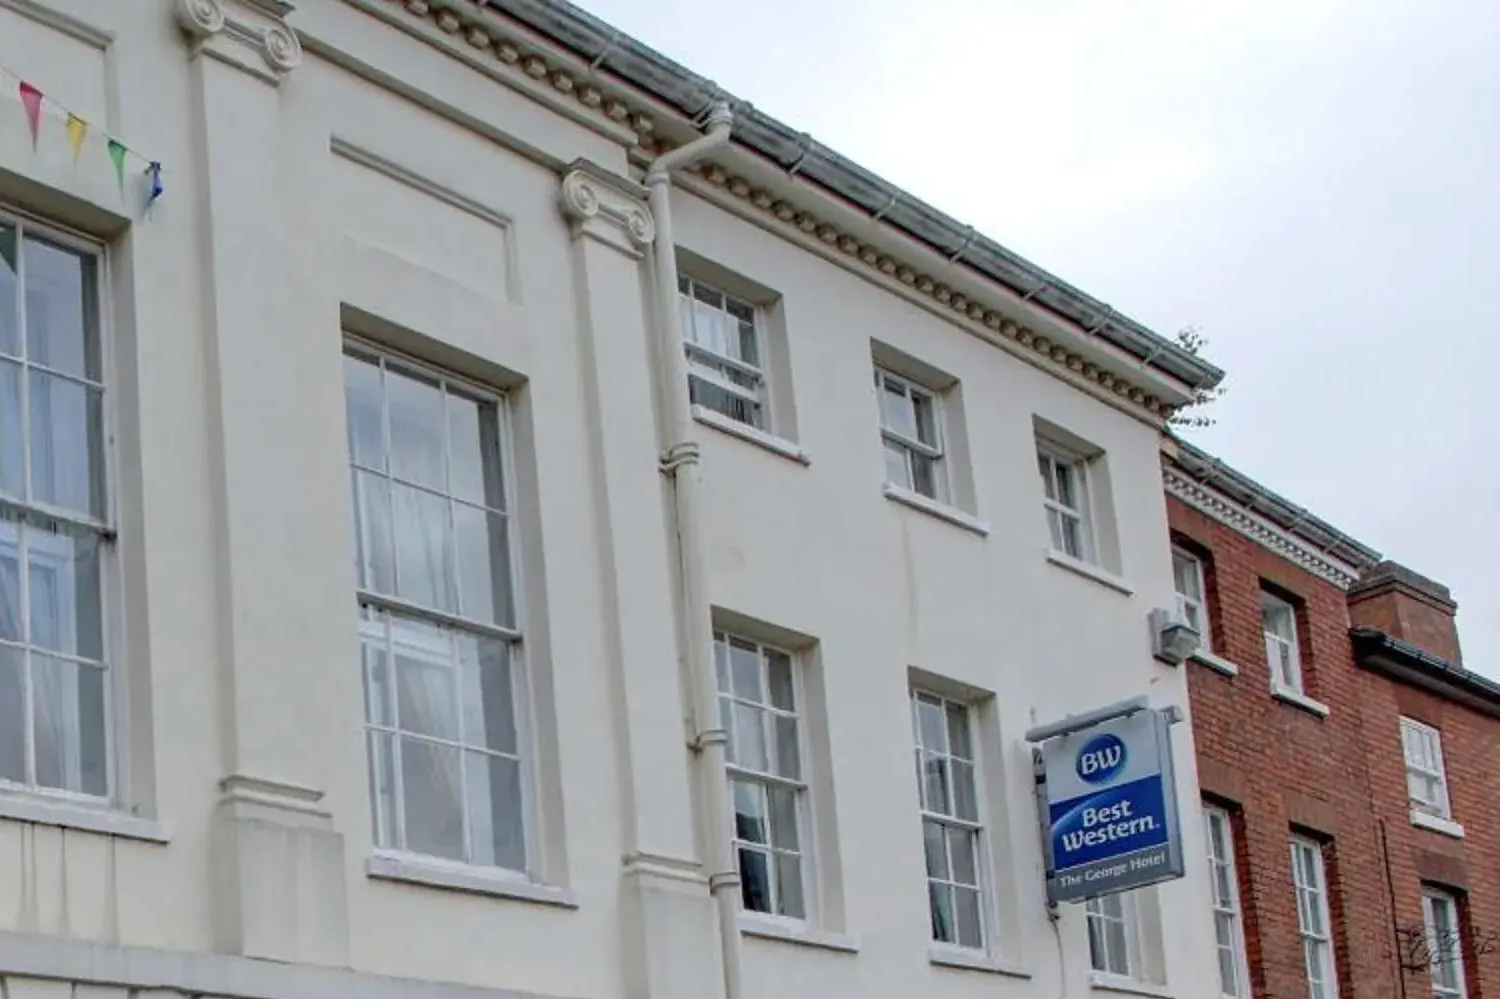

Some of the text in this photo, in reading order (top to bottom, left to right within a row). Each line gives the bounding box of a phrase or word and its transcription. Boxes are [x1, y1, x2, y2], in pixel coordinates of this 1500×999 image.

[1081, 745, 1121, 775] BW
[1082, 800, 1132, 827] Best
[1062, 815, 1154, 852] Western
[1060, 852, 1165, 888] The George Hotel
